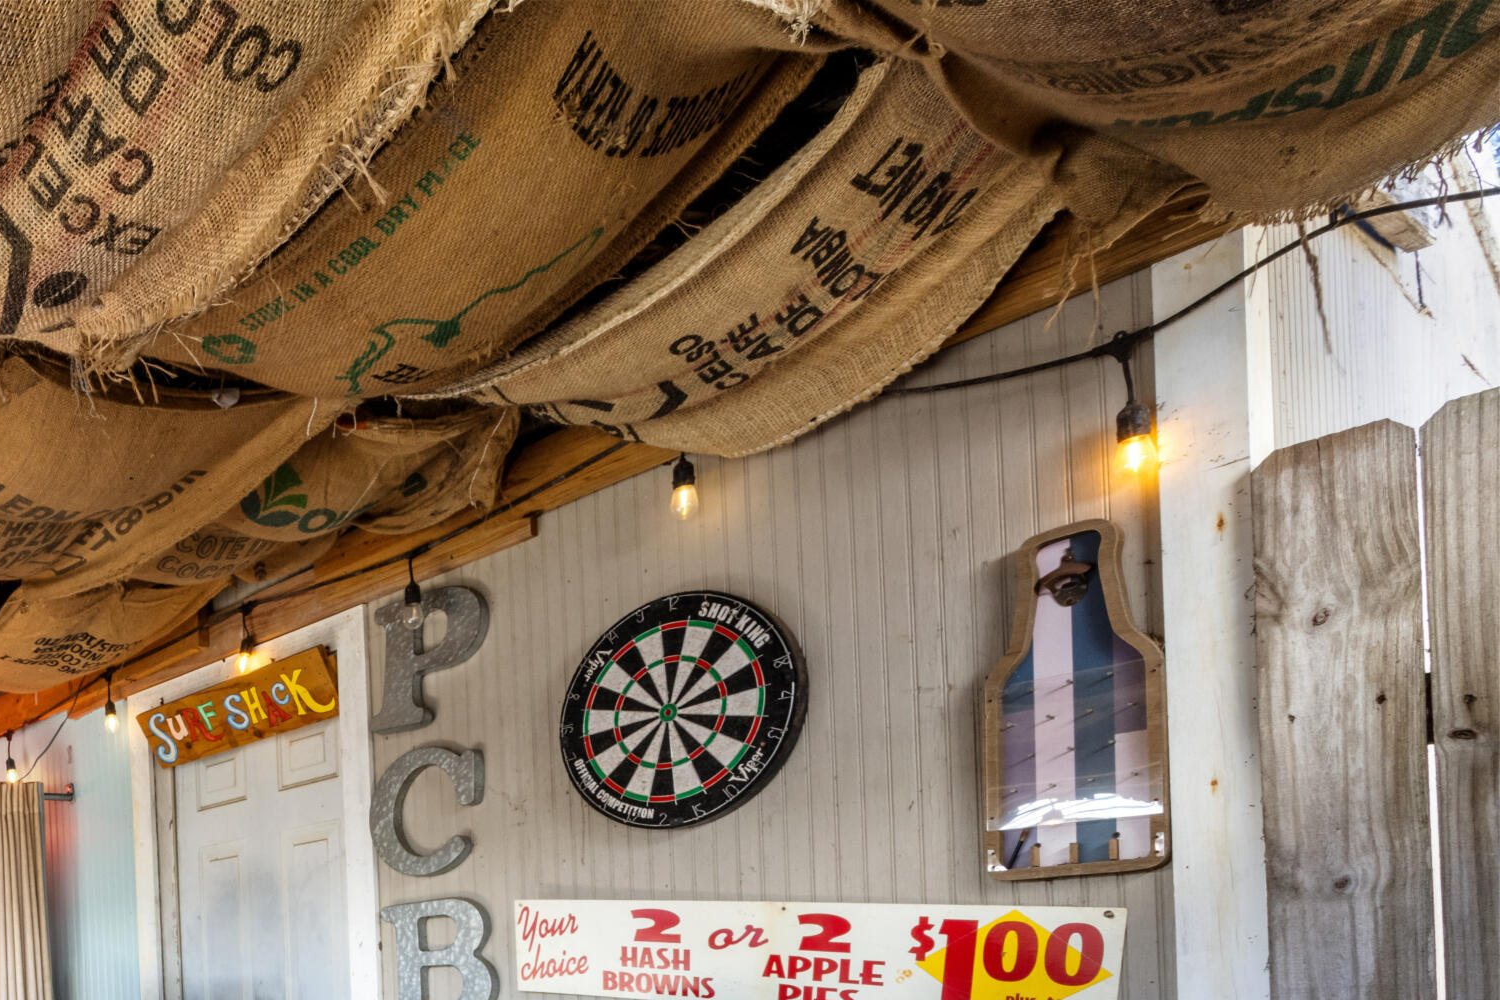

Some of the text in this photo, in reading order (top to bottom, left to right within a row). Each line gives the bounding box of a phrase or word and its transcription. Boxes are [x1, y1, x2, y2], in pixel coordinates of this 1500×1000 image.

[88, 3, 169, 117] DE
[850, 136, 928, 223] NET
[289, 280, 318, 304] IN
[313, 271, 334, 289] A
[326, 235, 382, 276] COOL
[373, 193, 422, 237] DRY
[774, 292, 826, 338] DE
[699, 600, 771, 650] SHOT KING
[584, 647, 613, 684] Viper
[146, 668, 336, 765] SURF SHACK
[729, 746, 764, 784] Viper
[573, 757, 656, 820] OFFICIAL COMPETITION
[517, 905, 580, 944] Your
[632, 909, 682, 945] 2
[708, 919, 770, 952] or
[798, 914, 853, 955] 2
[520, 947, 589, 986] choice
[621, 947, 691, 972] HASH
[763, 955, 886, 988] APPLE
[603, 972, 716, 1000] BROWNS
